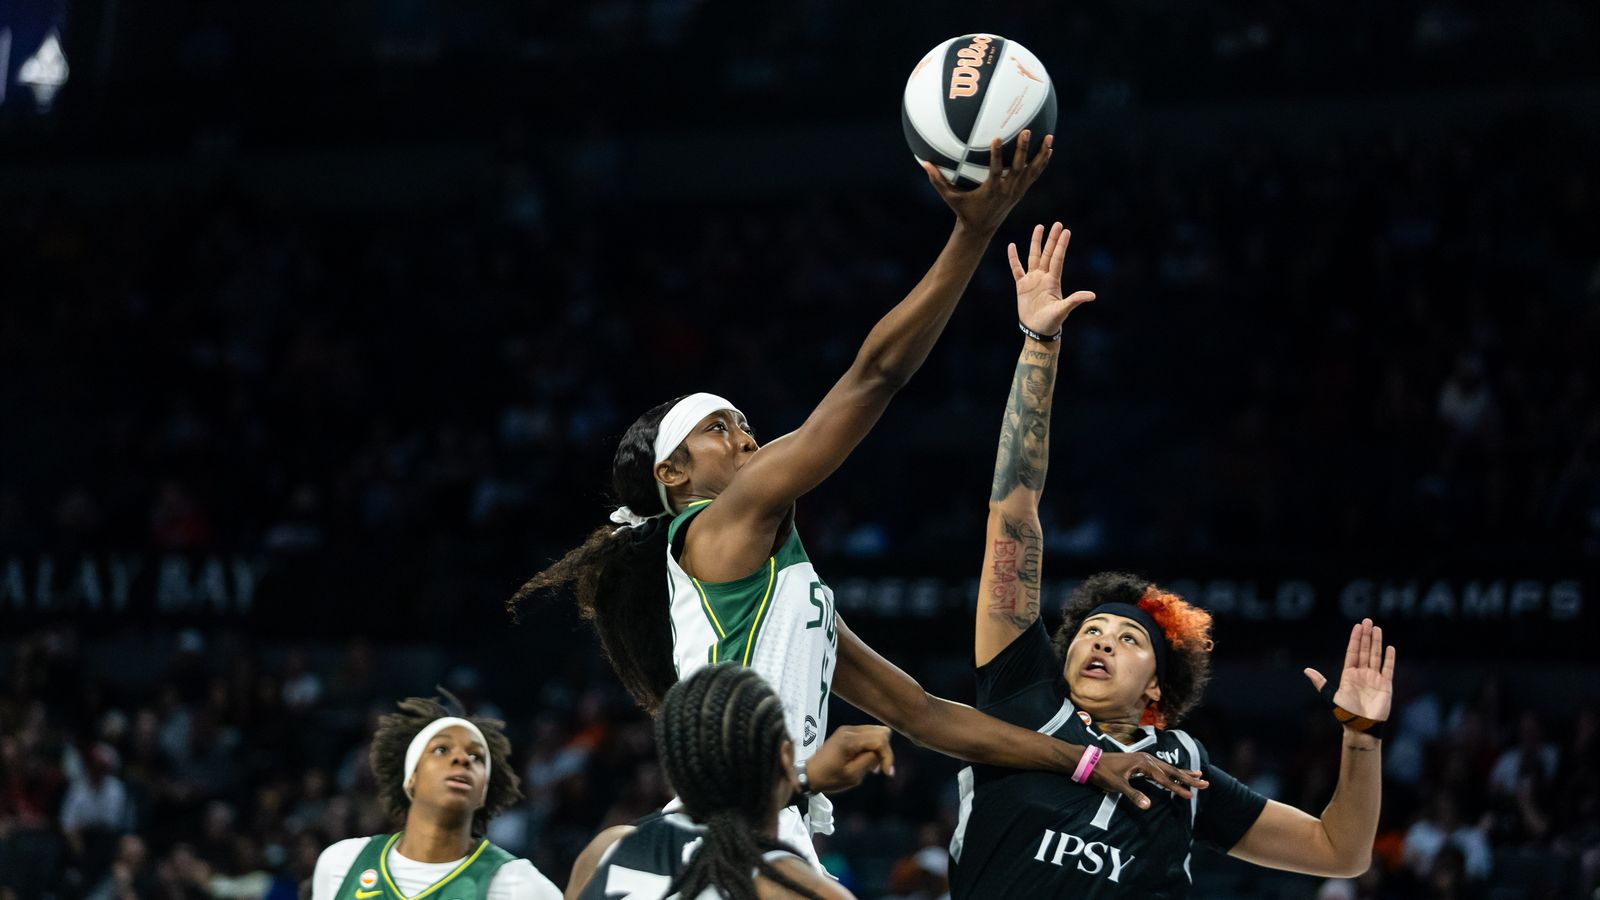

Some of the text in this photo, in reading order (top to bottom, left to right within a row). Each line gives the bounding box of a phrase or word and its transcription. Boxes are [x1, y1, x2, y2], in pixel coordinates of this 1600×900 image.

[949, 35, 992, 99] Wilso
[155, 552, 268, 615] BAY
[990, 539, 1017, 613] BEAST
[1338, 577, 1585, 620] CHAMPS
[1034, 828, 1136, 883] IPSY
